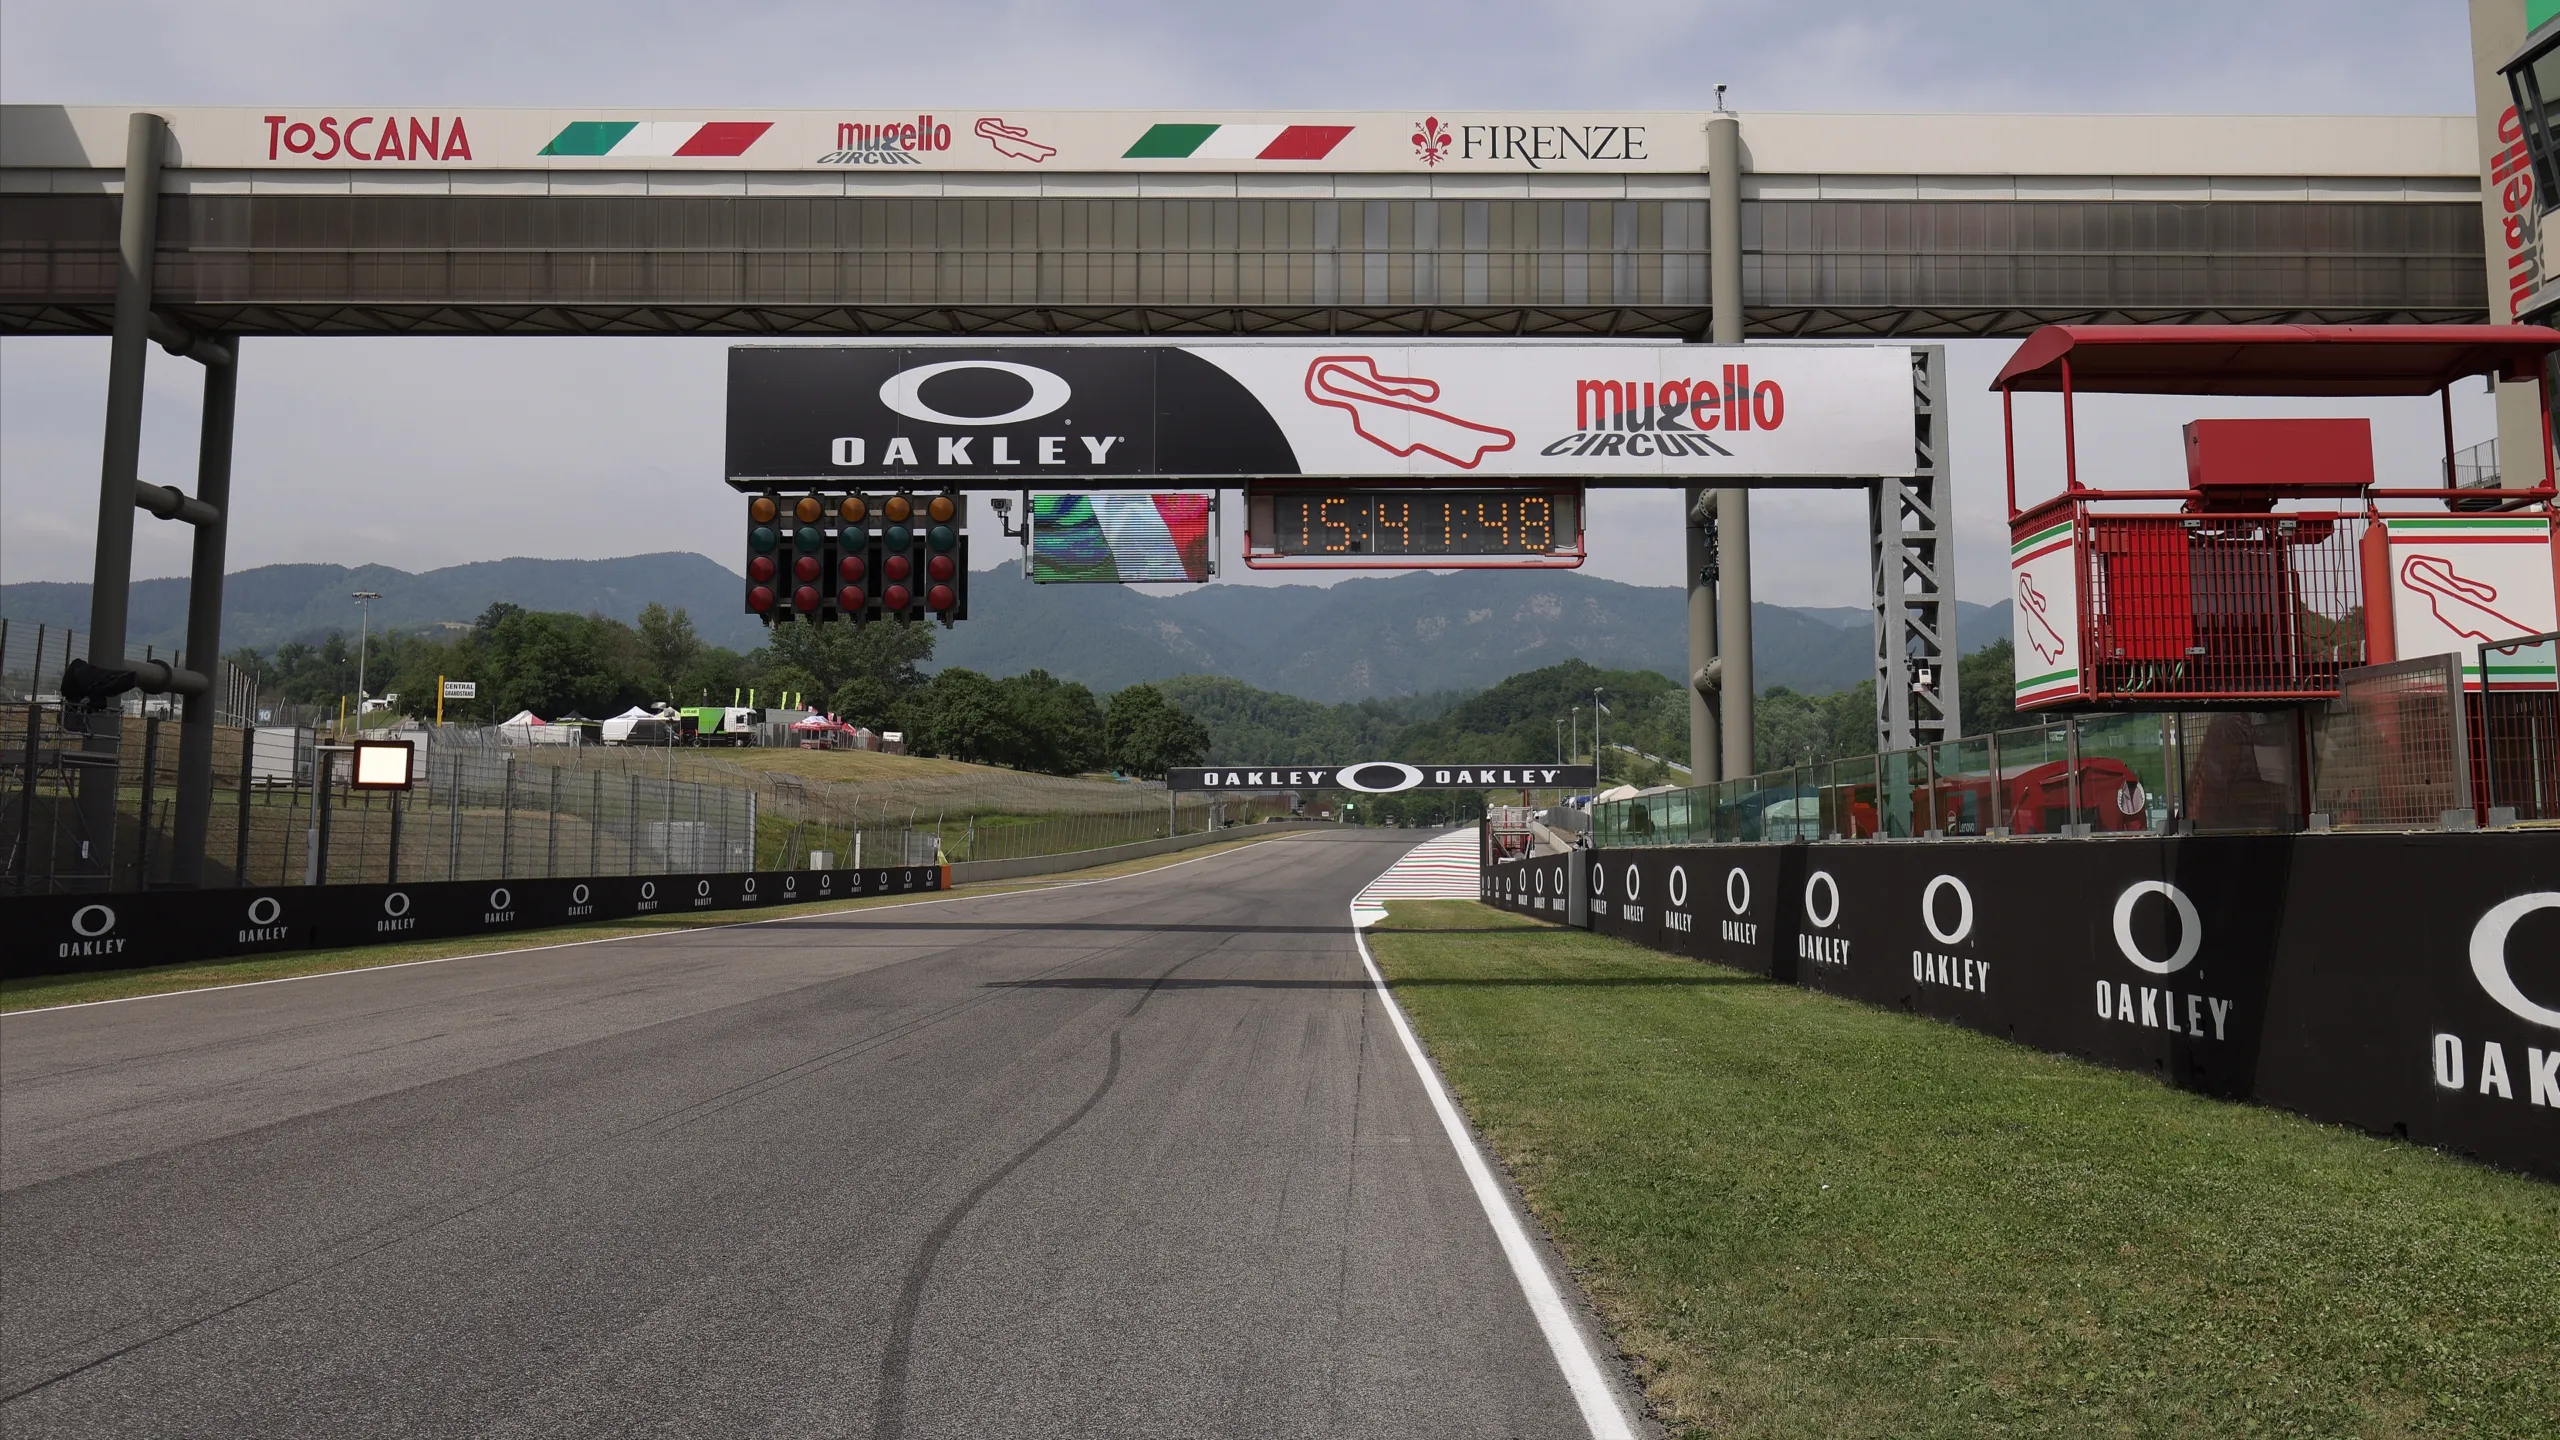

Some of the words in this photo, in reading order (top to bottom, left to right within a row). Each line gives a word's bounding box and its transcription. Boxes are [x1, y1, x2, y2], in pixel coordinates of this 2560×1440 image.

[837, 115, 951, 152] mugello
[816, 151, 922, 165] CIRCUIT
[1461, 126, 1647, 169] FIRENZE
[1576, 364, 1784, 433] mugello
[831, 436, 1118, 466] OAKLEY
[1540, 433, 1735, 457] CIRCUIT
[1302, 496, 1550, 550] 15:41:48
[258, 710, 271, 721] 10
[1204, 771, 1323, 786] OAKLEY
[1435, 769, 1556, 784] OAKLEY
[1958, 820, 1976, 834] Lenovo
[484, 911, 514, 924] OAKLEY
[568, 905, 592, 916] OAKLEY
[1623, 904, 1644, 922] OAKLEY
[377, 917, 414, 932] OAKLEY
[1665, 910, 1692, 933] OAKLEY
[1721, 919, 1757, 945] OAKLEY
[238, 926, 286, 943] OAKLEY
[59, 938, 124, 958] OAKLEY
[1799, 933, 1849, 966] OAKLEY
[1912, 950, 1988, 994] OAKLEY
[2096, 978, 2228, 1042] OAKLEY
